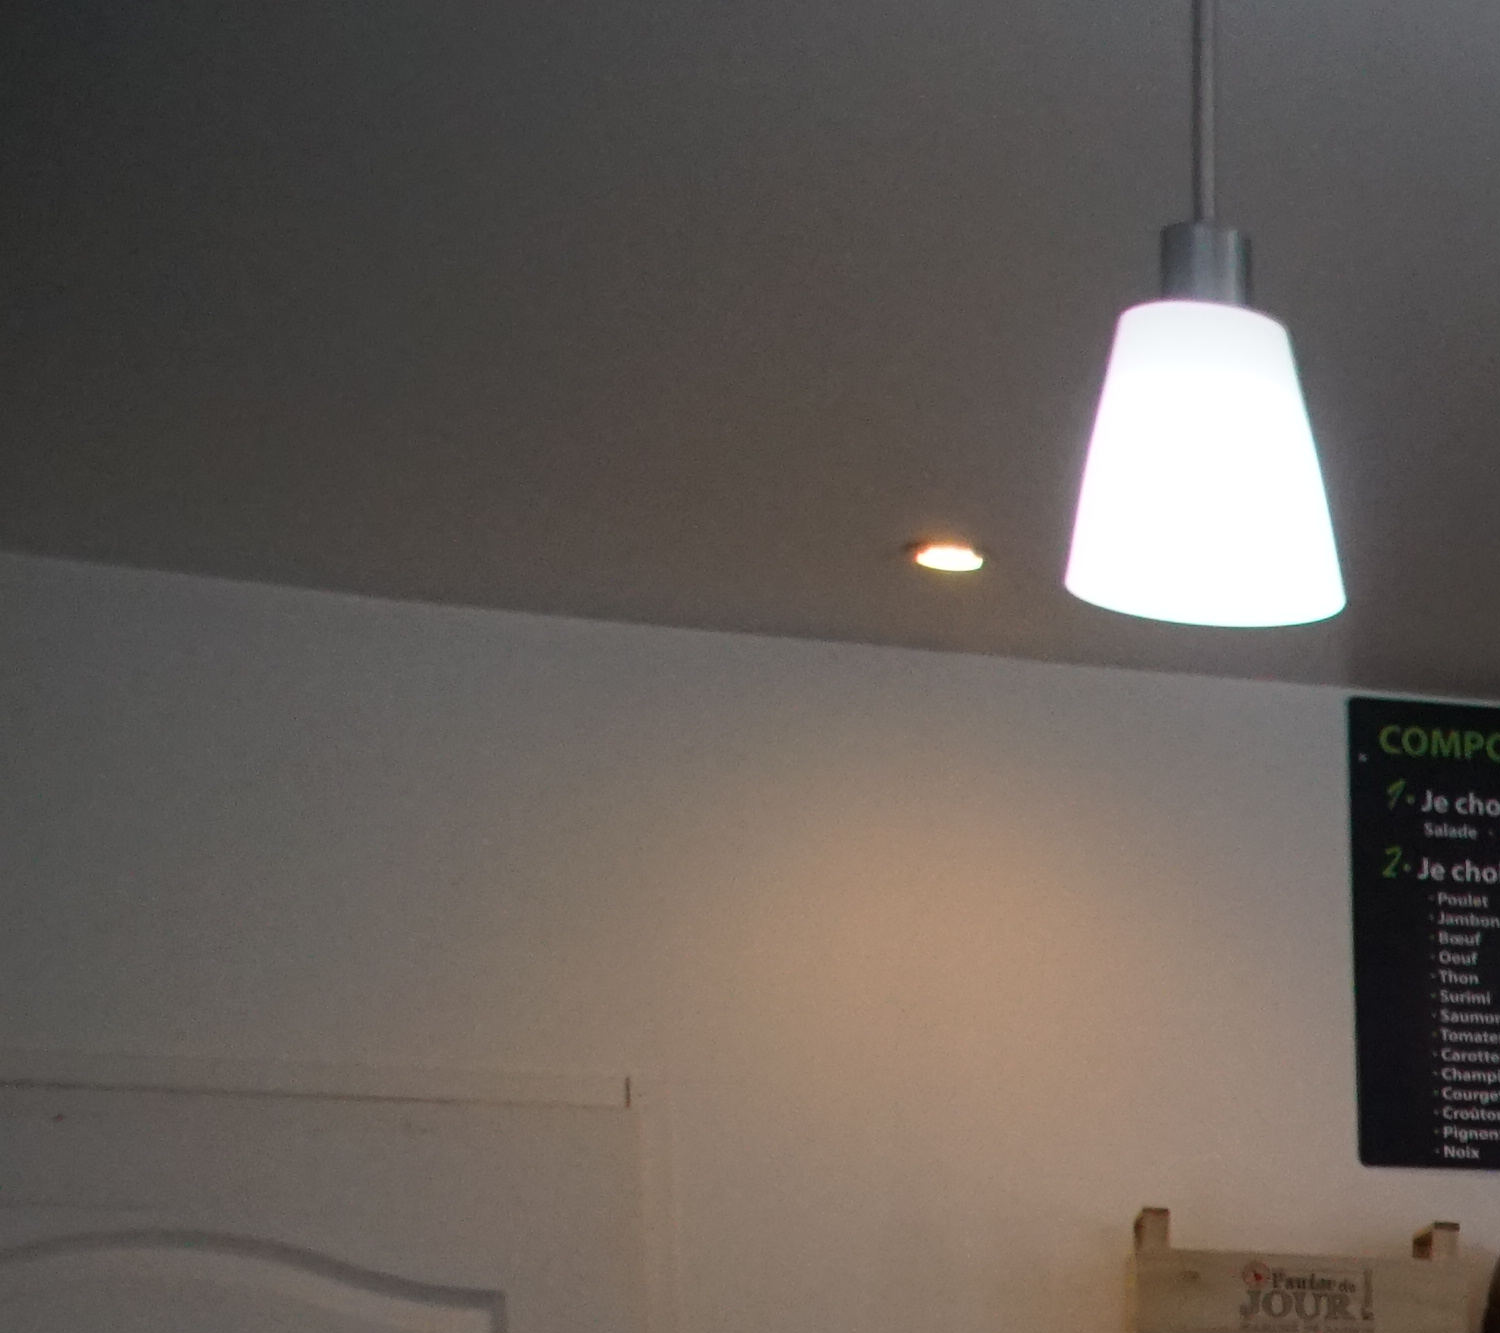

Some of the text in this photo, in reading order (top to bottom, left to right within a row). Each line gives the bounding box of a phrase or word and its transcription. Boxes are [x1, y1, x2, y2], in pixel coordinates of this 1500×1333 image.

[1421, 790, 1449, 813] Je
[1424, 822, 1477, 840] Salade
[1417, 857, 1445, 881] Je
[1437, 893, 1489, 908] Poulet
[1437, 912, 1500, 928] Jambon
[1439, 952, 1478, 966] Oeuf
[1440, 971, 1479, 985] Thon
[1440, 990, 1491, 1006] Surimi
[1443, 1146, 1480, 1160] Noix
[1240, 1290, 1357, 1321] JOUR
